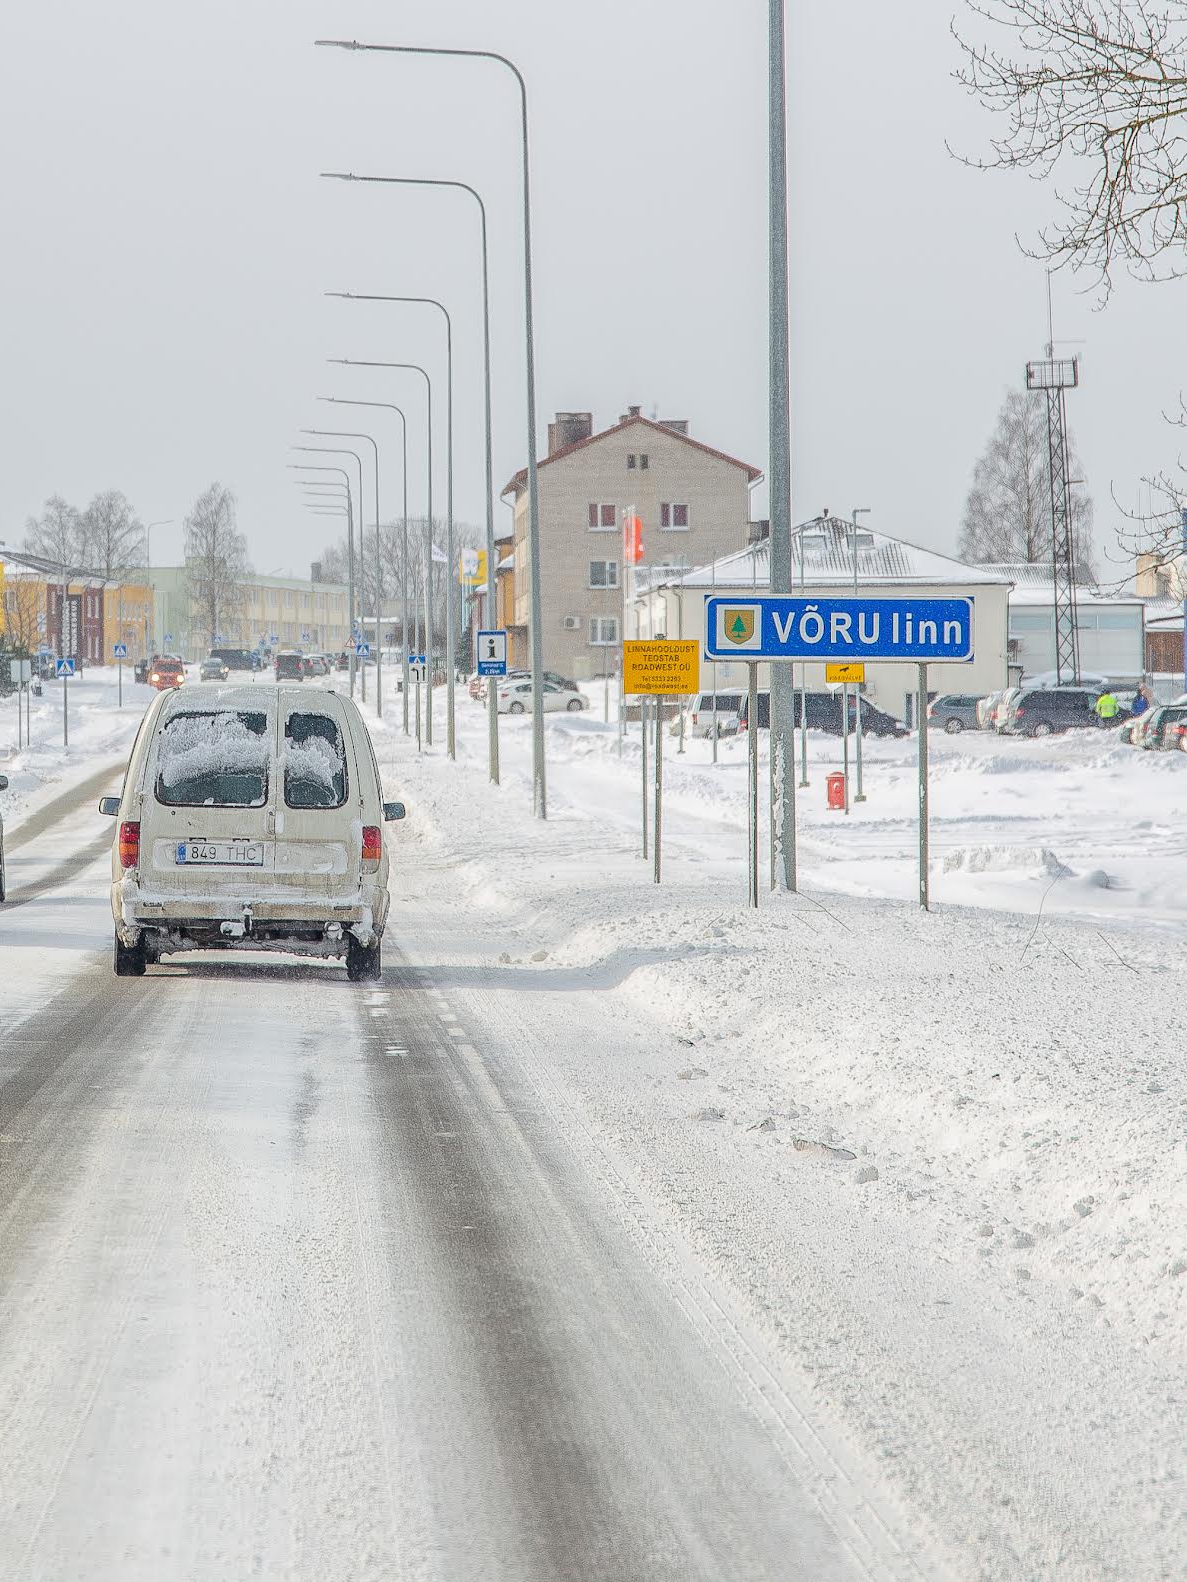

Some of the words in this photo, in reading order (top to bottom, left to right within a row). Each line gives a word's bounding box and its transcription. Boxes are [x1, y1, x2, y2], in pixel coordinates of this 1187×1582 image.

[771, 604, 880, 645] VÕRU
[892, 611, 962, 645] linn
[627, 645, 695, 653] LINNAHOOLDUST
[643, 654, 680, 662] TEOSTAB
[631, 663, 677, 671] ROADWEST
[191, 846, 217, 860] 849
[226, 846, 256, 861] THC
